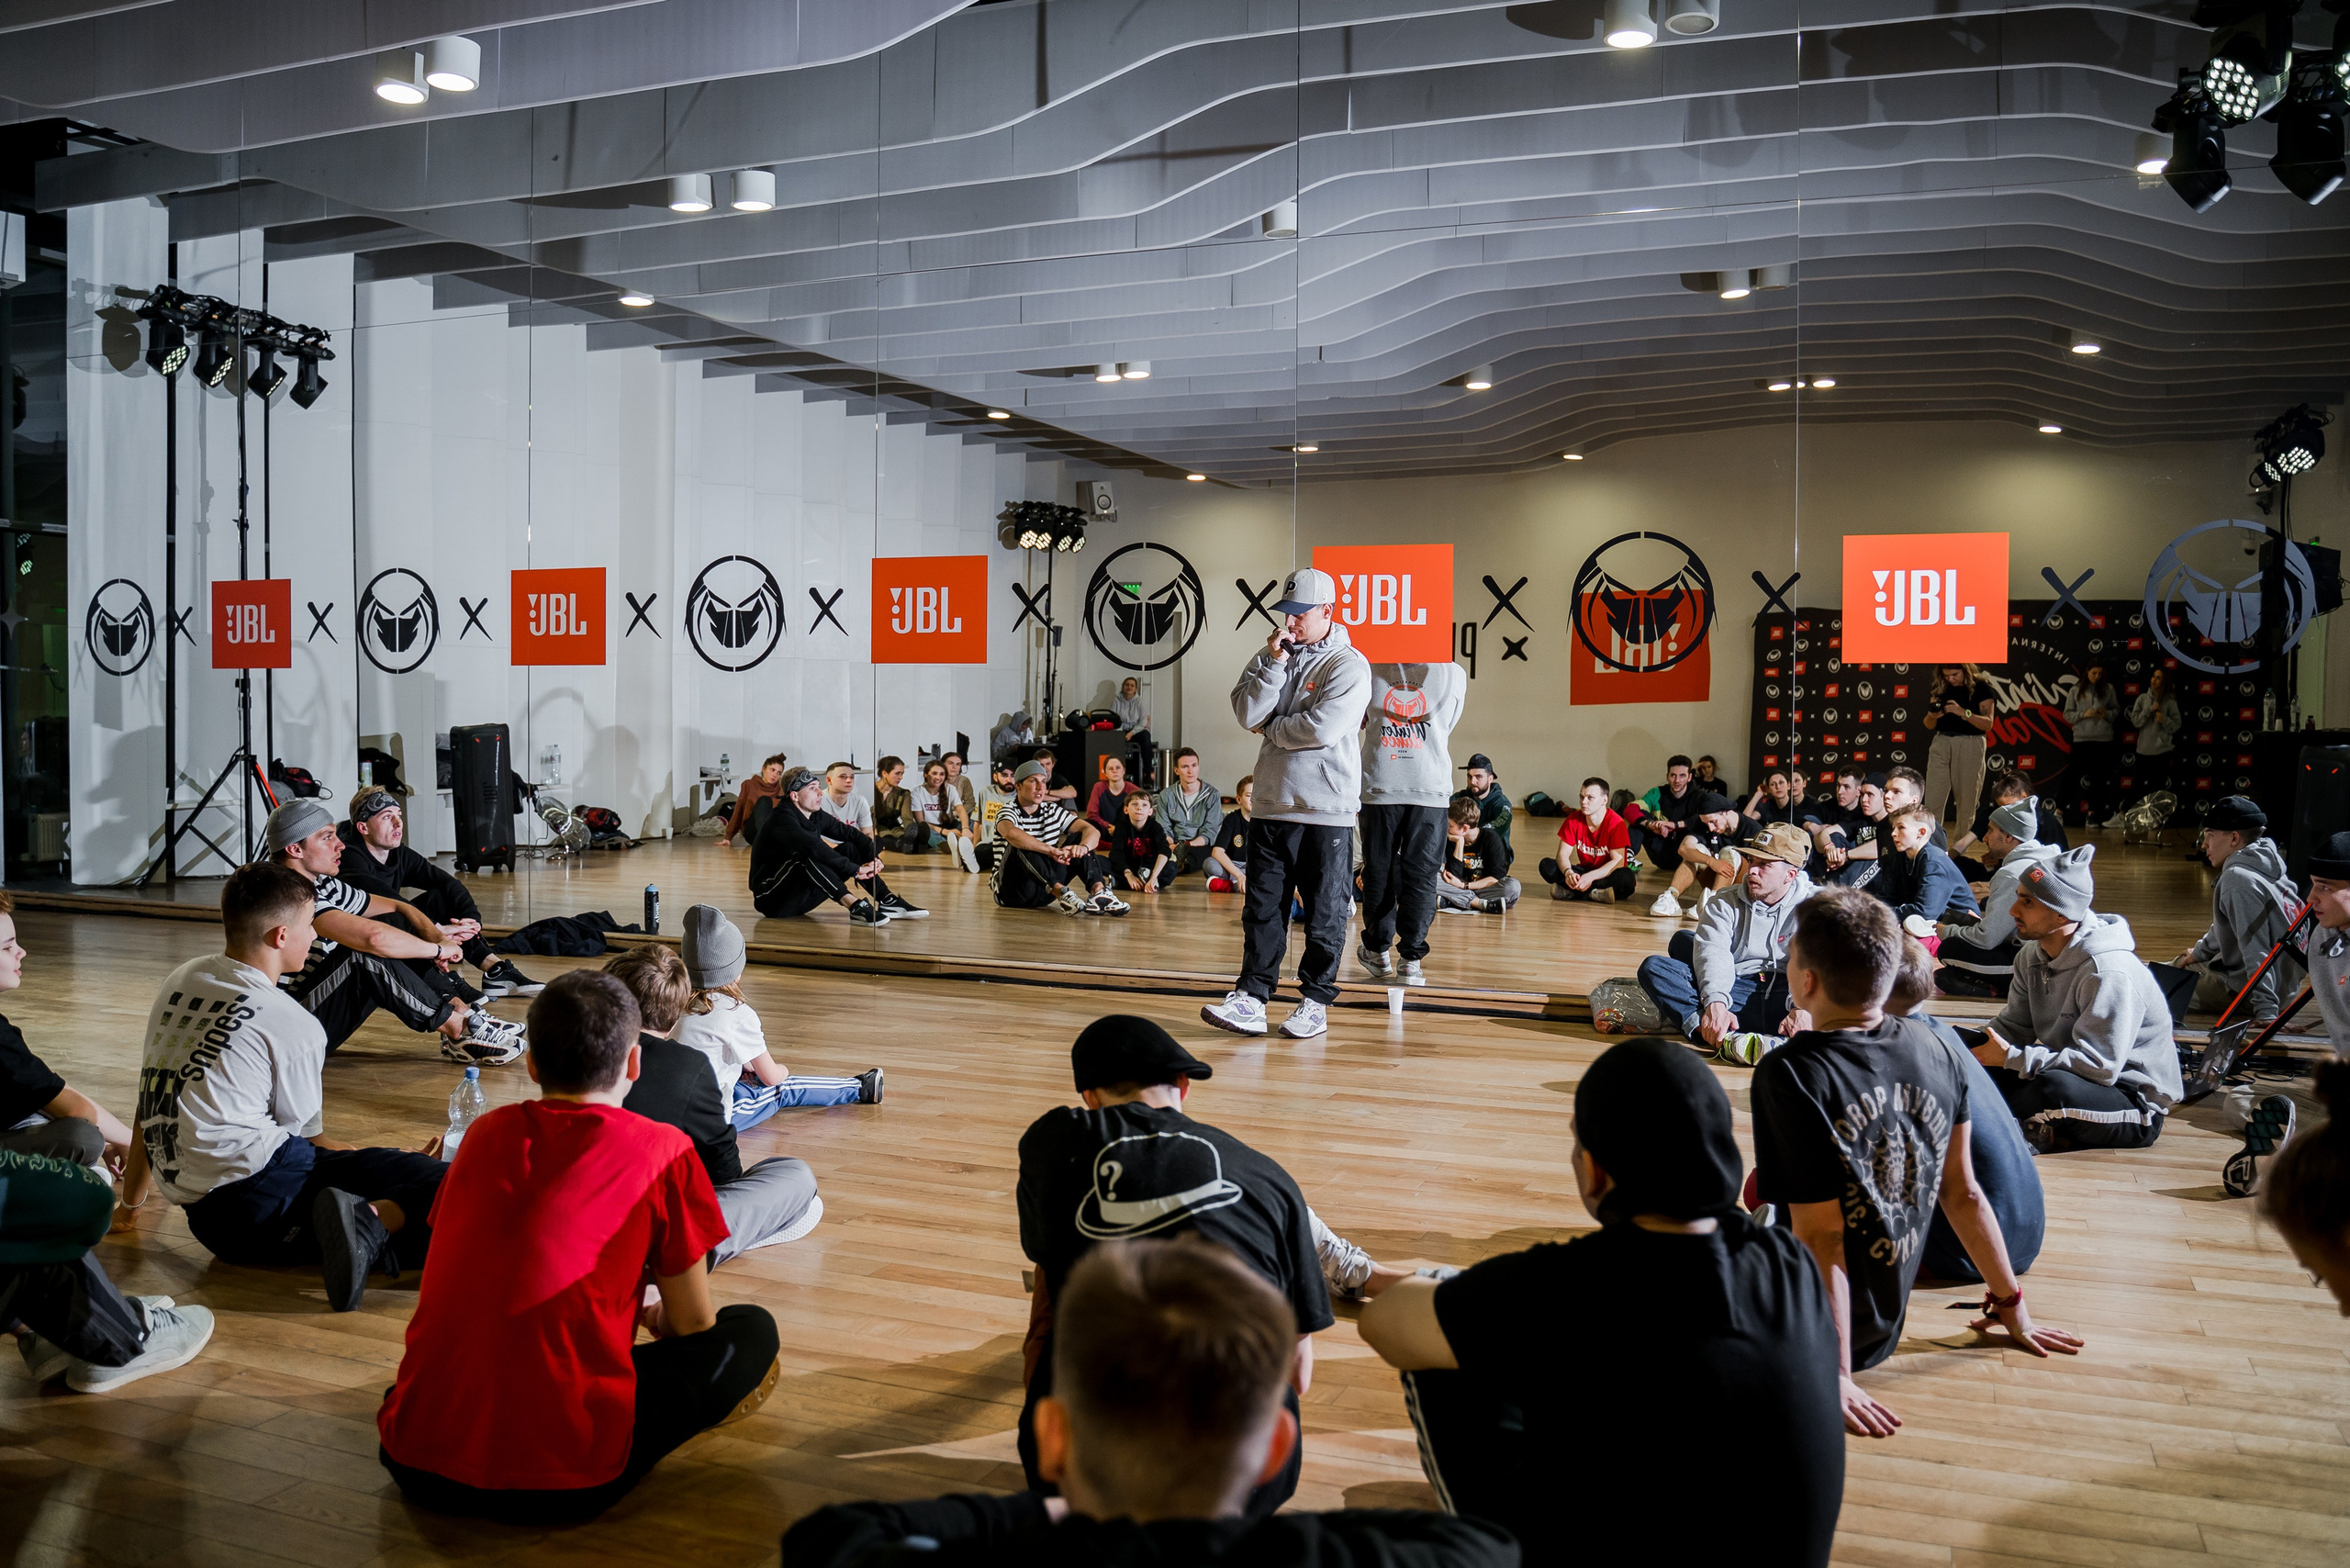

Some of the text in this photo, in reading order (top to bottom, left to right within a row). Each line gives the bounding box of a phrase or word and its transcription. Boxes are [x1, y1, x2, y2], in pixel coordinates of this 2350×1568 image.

[227, 605, 275, 643] JBL
[528, 594, 587, 635] JBL
[890, 588, 962, 633] JBL
[1340, 575, 1427, 625] JBL
[1873, 569, 1976, 627] JBL
[1284, 580, 1297, 595] P
[180, 1002, 256, 1082] snipes
